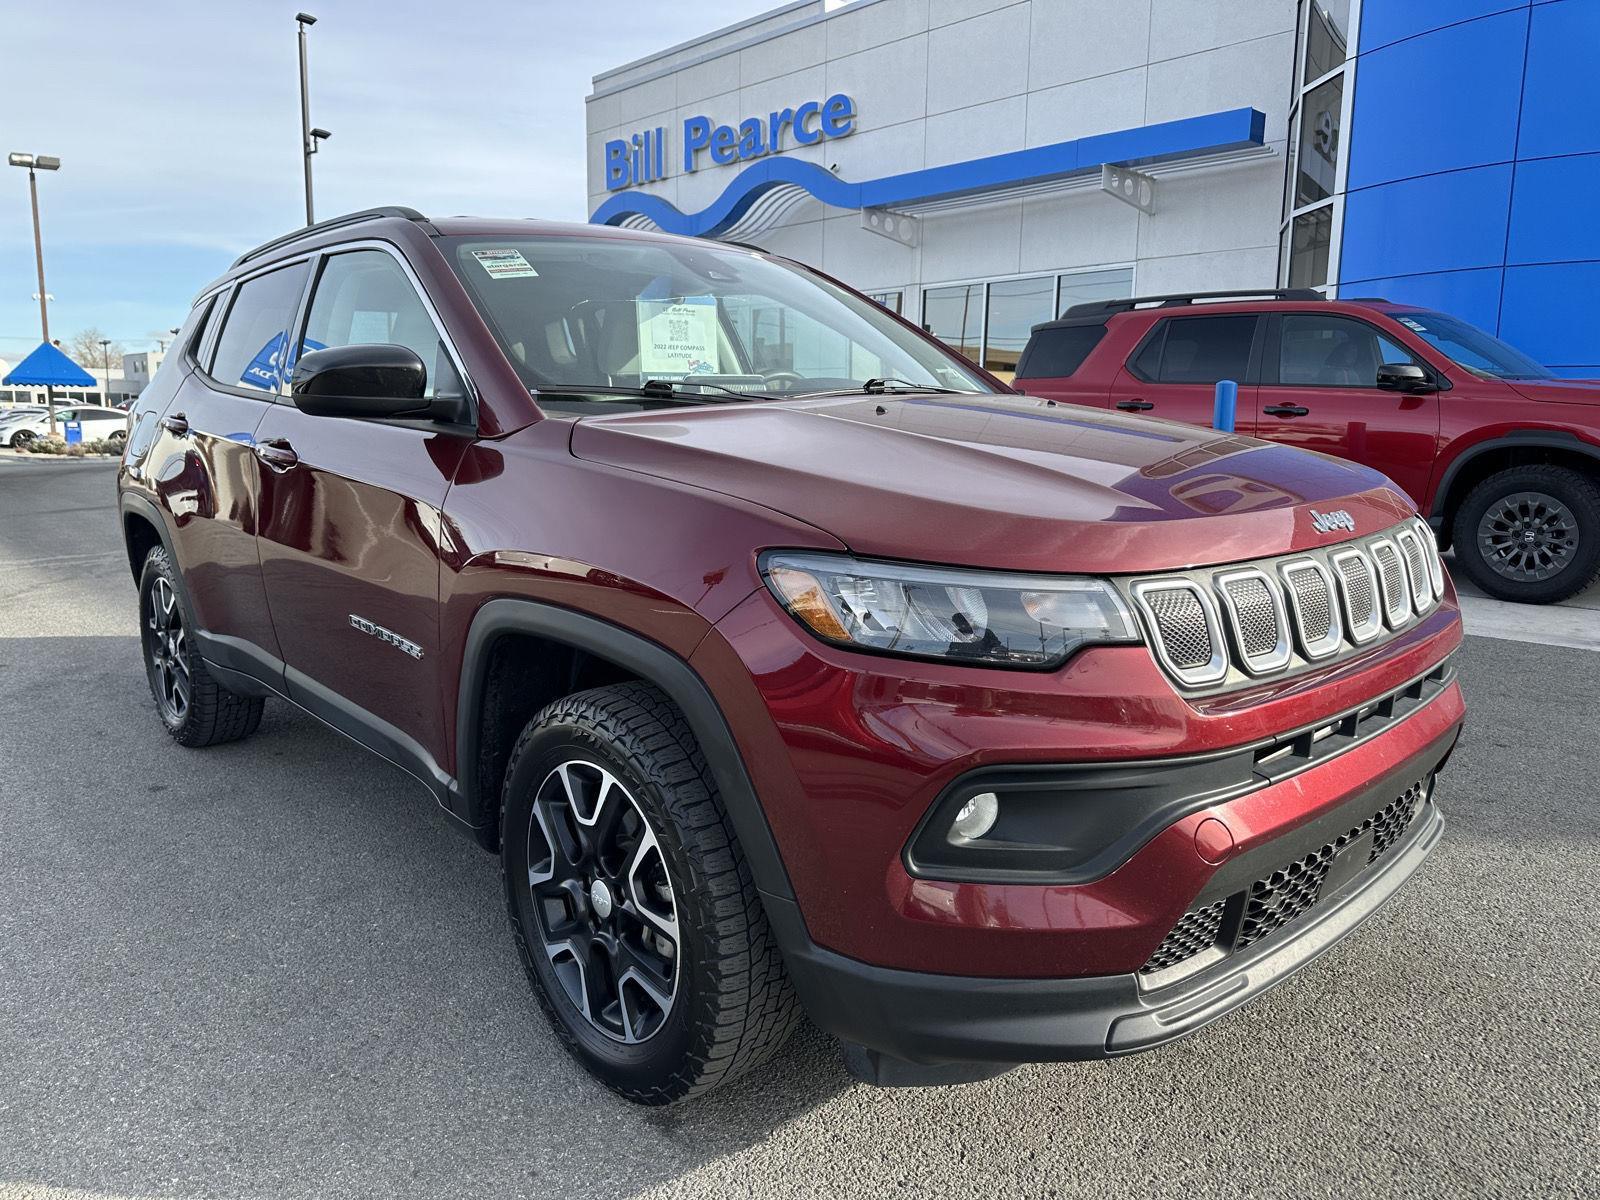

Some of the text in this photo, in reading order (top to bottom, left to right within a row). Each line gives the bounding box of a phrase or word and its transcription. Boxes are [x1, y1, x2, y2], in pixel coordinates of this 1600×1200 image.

[605, 93, 858, 191] Bill Pearce
[1308, 509, 1355, 533] Jeep
[348, 613, 424, 660] COMPASS
